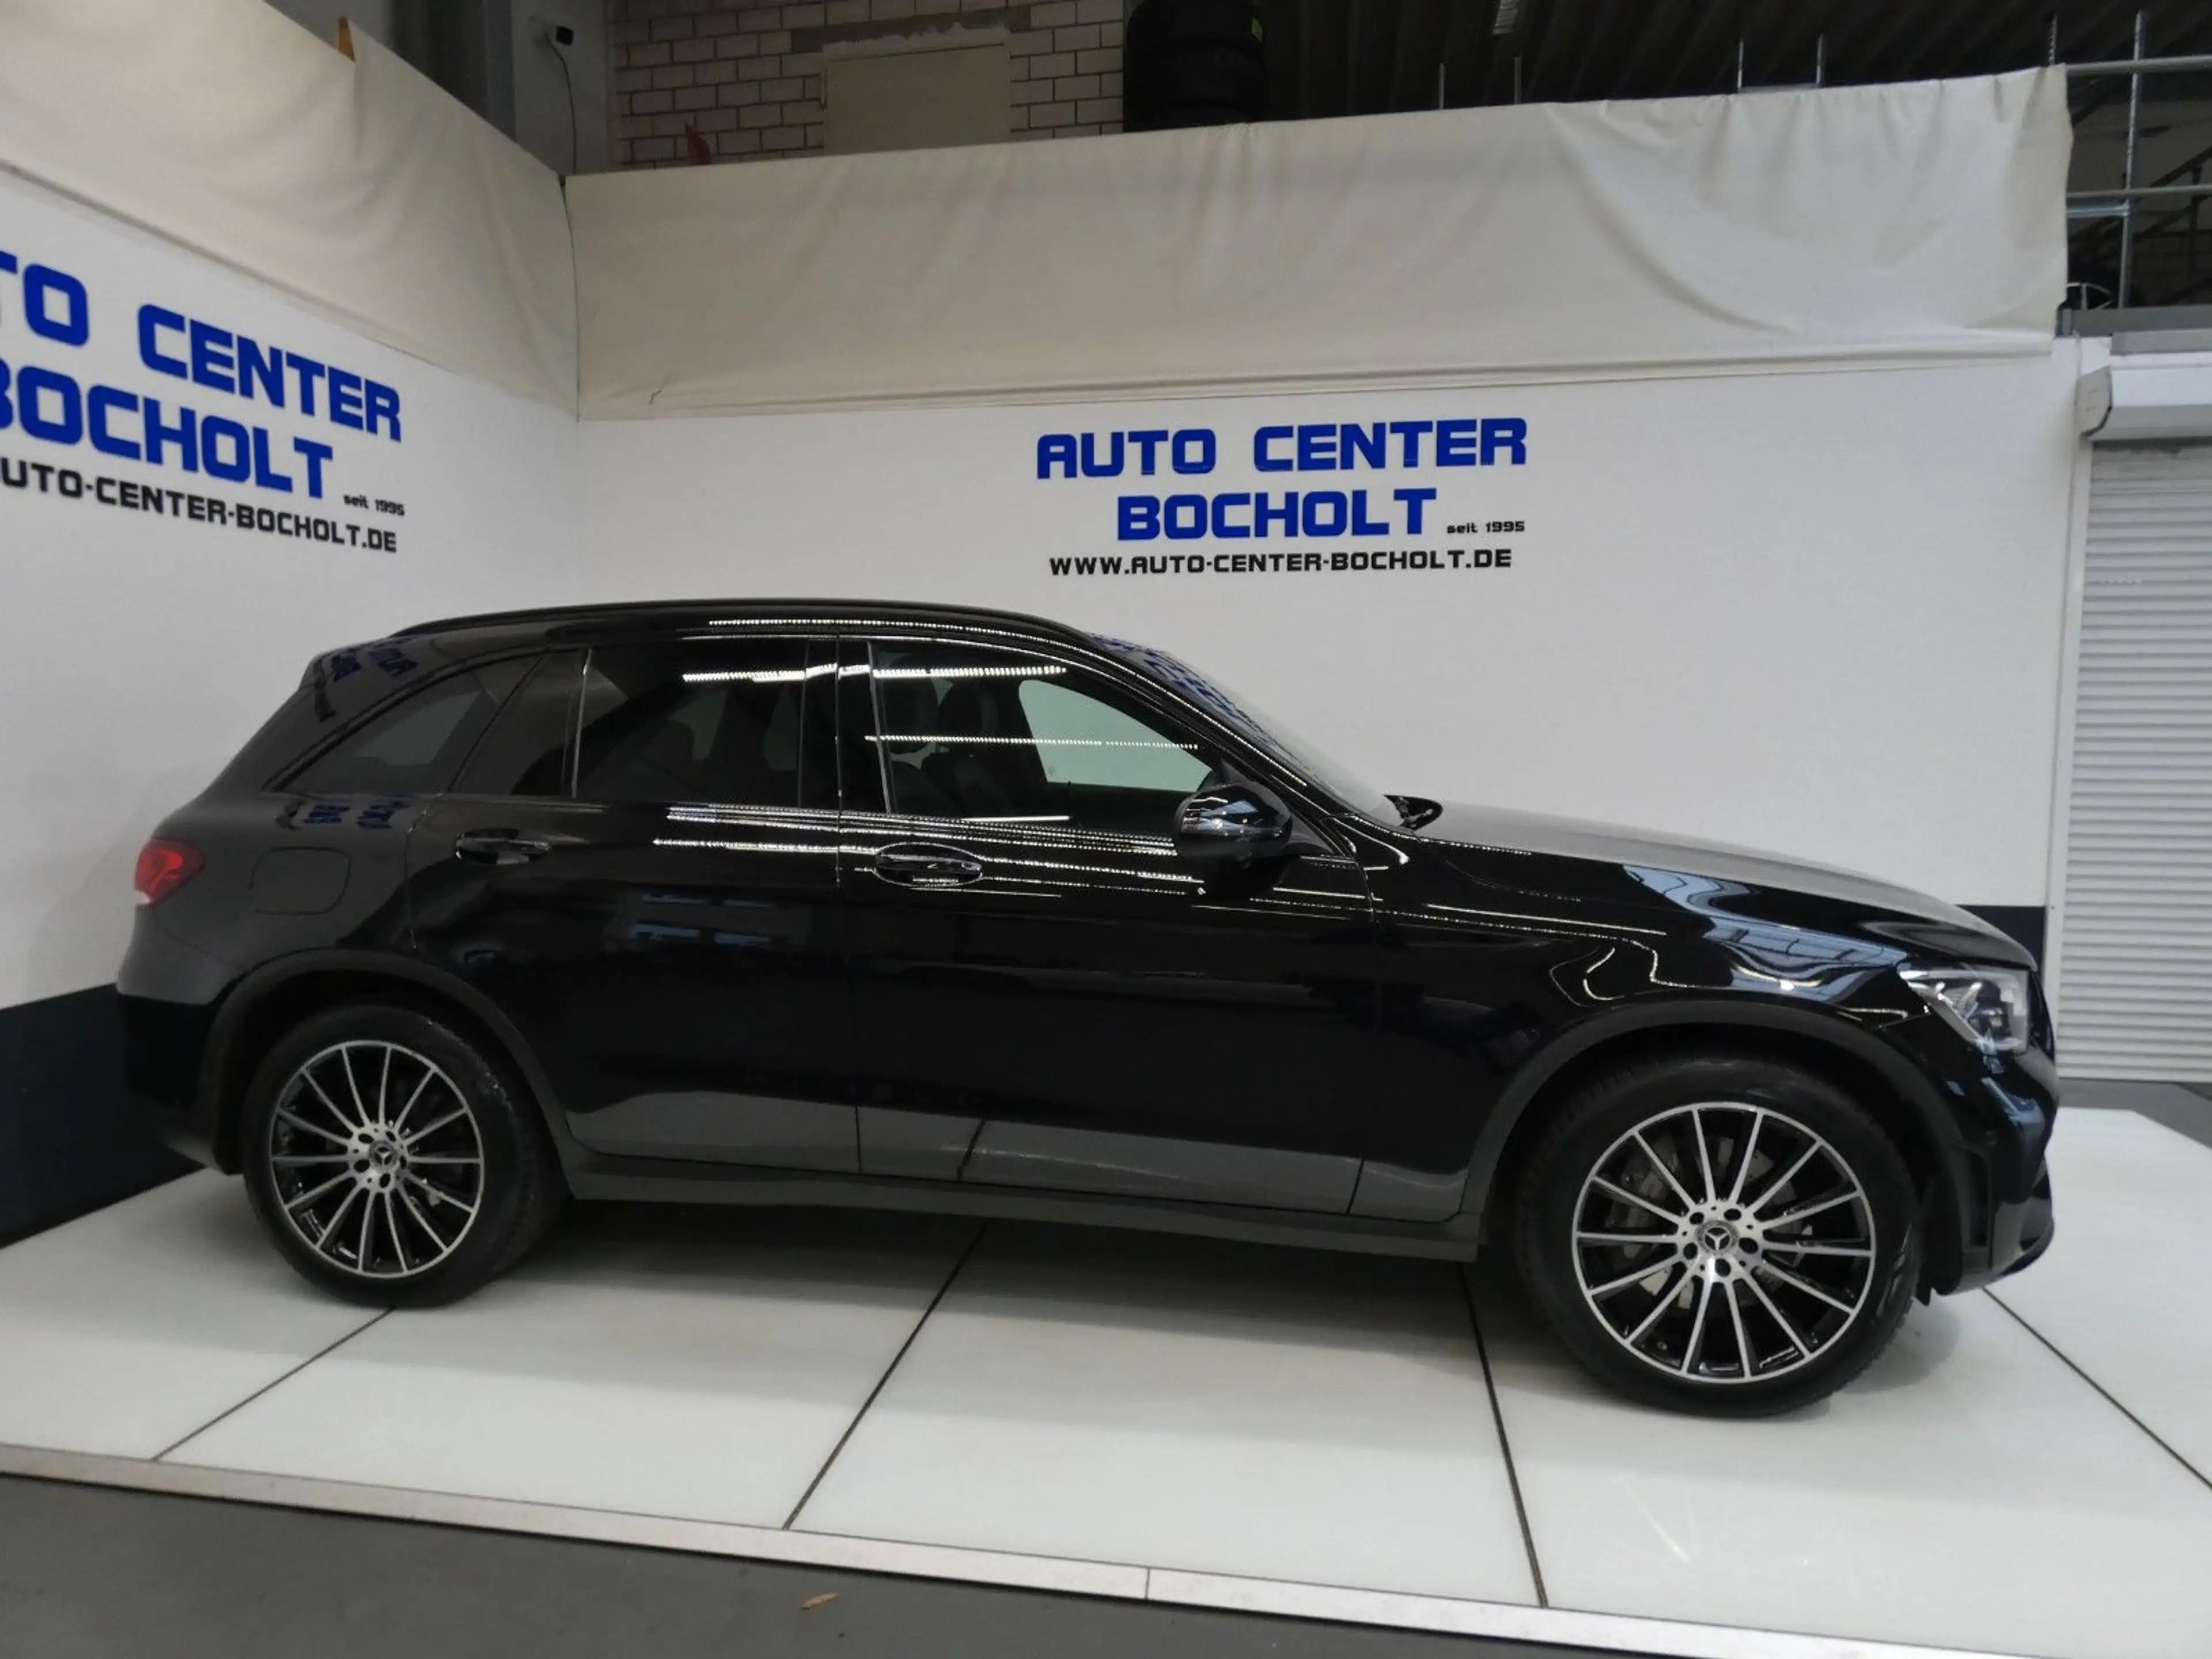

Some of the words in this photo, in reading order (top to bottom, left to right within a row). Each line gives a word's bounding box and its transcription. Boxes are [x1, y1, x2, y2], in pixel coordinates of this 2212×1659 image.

[0, 250, 89, 347] O
[137, 304, 402, 442] CENTER
[0, 357, 333, 499] OCHOLT
[343, 494, 369, 509] seit
[375, 498, 405, 517] 1995
[1037, 429, 1217, 479] AUTO
[1253, 417, 1528, 472] CENTER
[1117, 487, 1437, 541] BOCHOLT
[1446, 522, 1478, 534] seit
[1486, 520, 1525, 533] 1995
[1049, 548, 1513, 577] WWW.AUTO-CENTER-BOCHOLT.DE
